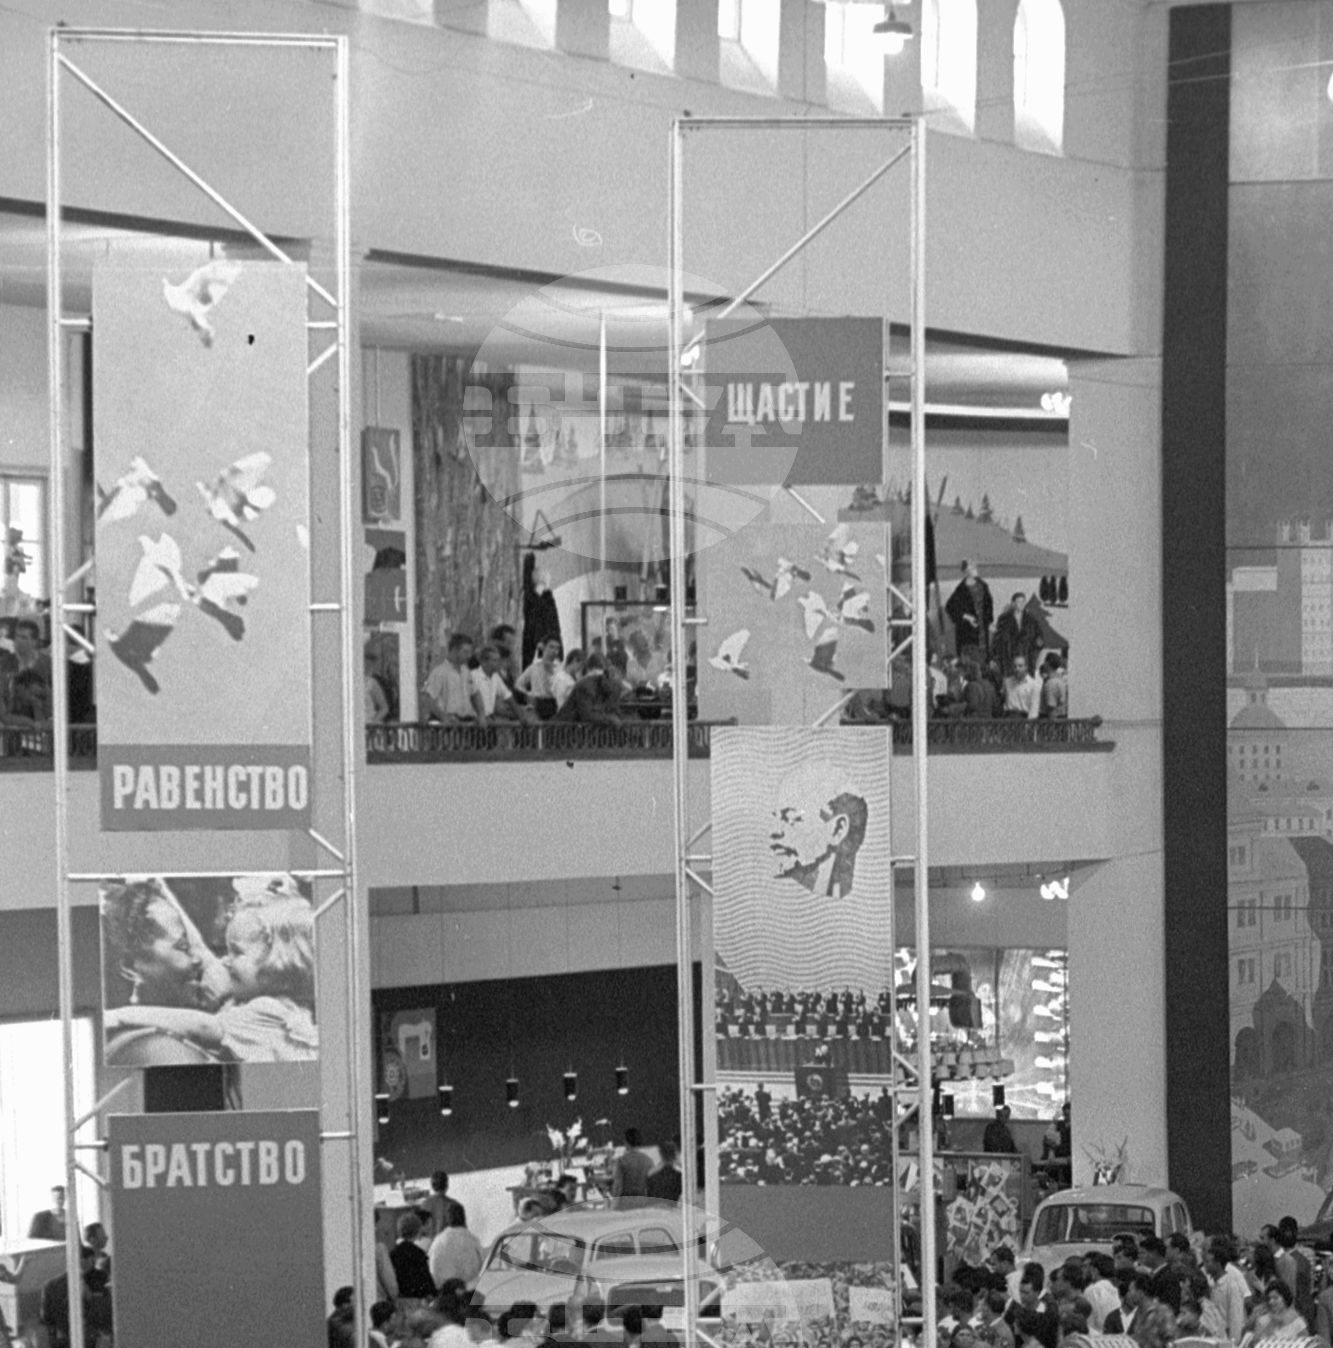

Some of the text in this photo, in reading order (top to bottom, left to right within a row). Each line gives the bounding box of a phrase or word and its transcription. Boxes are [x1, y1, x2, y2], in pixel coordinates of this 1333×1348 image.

[727, 381, 856, 426] ЩАСТИЕ
[112, 764, 308, 810] РАВЕНСТВО
[121, 1139, 307, 1190] БРАТСТВО
